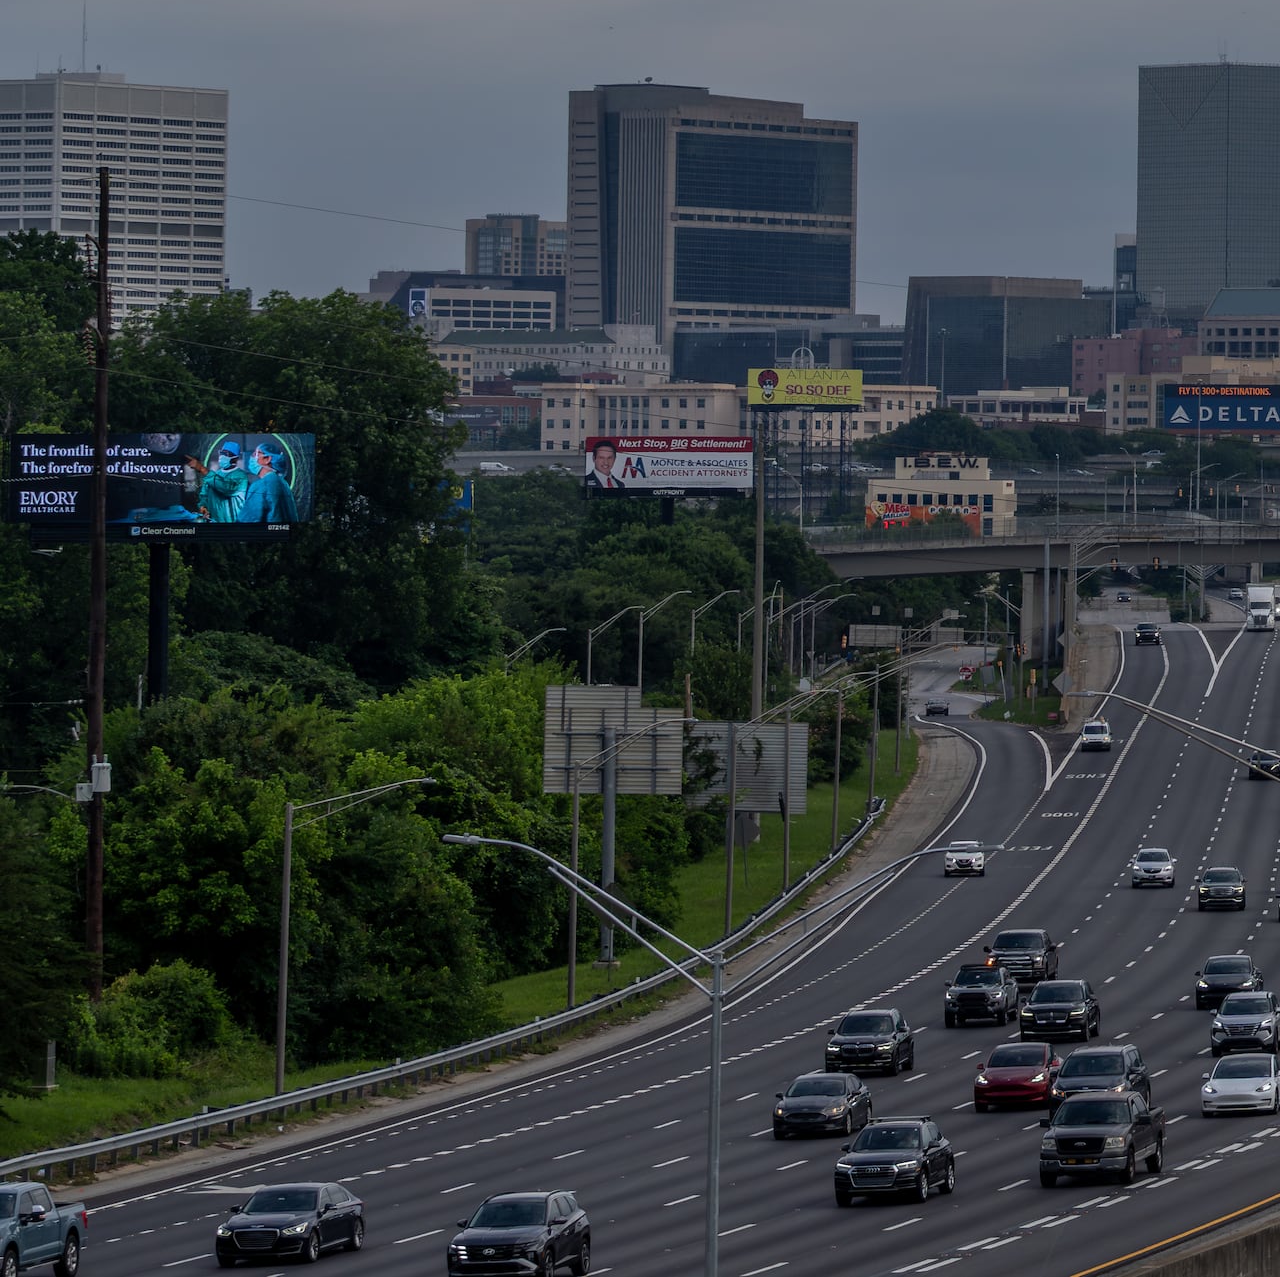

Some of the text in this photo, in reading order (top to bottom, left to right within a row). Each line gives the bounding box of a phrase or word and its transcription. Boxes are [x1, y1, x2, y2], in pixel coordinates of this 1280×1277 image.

[787, 370, 850, 380] ATLANTA
[786, 384, 852, 396] SO SO DEF
[1178, 387, 1191, 396] FLY
[1201, 387, 1220, 396] 300+
[1220, 387, 1272, 396] DESTINATIONS.
[1199, 406, 1280, 422] DELTA
[619, 439, 746, 449] Next Stop, BIG Settlement!
[21, 444, 152, 457] The frontlin of care.
[650, 459, 748, 467] MONGE & ASSOCIATES
[903, 458, 979, 468] I.B.E.W.
[21, 462, 49, 474] The
[107, 461, 121, 474] of
[122, 462, 184, 476] discovery.
[650, 469, 748, 477] ACCIDENT ATTORNEYS
[19, 491, 79, 506] EMORY
[885, 503, 910, 513] MEGA
[141, 526, 196, 535] Clear Channel
